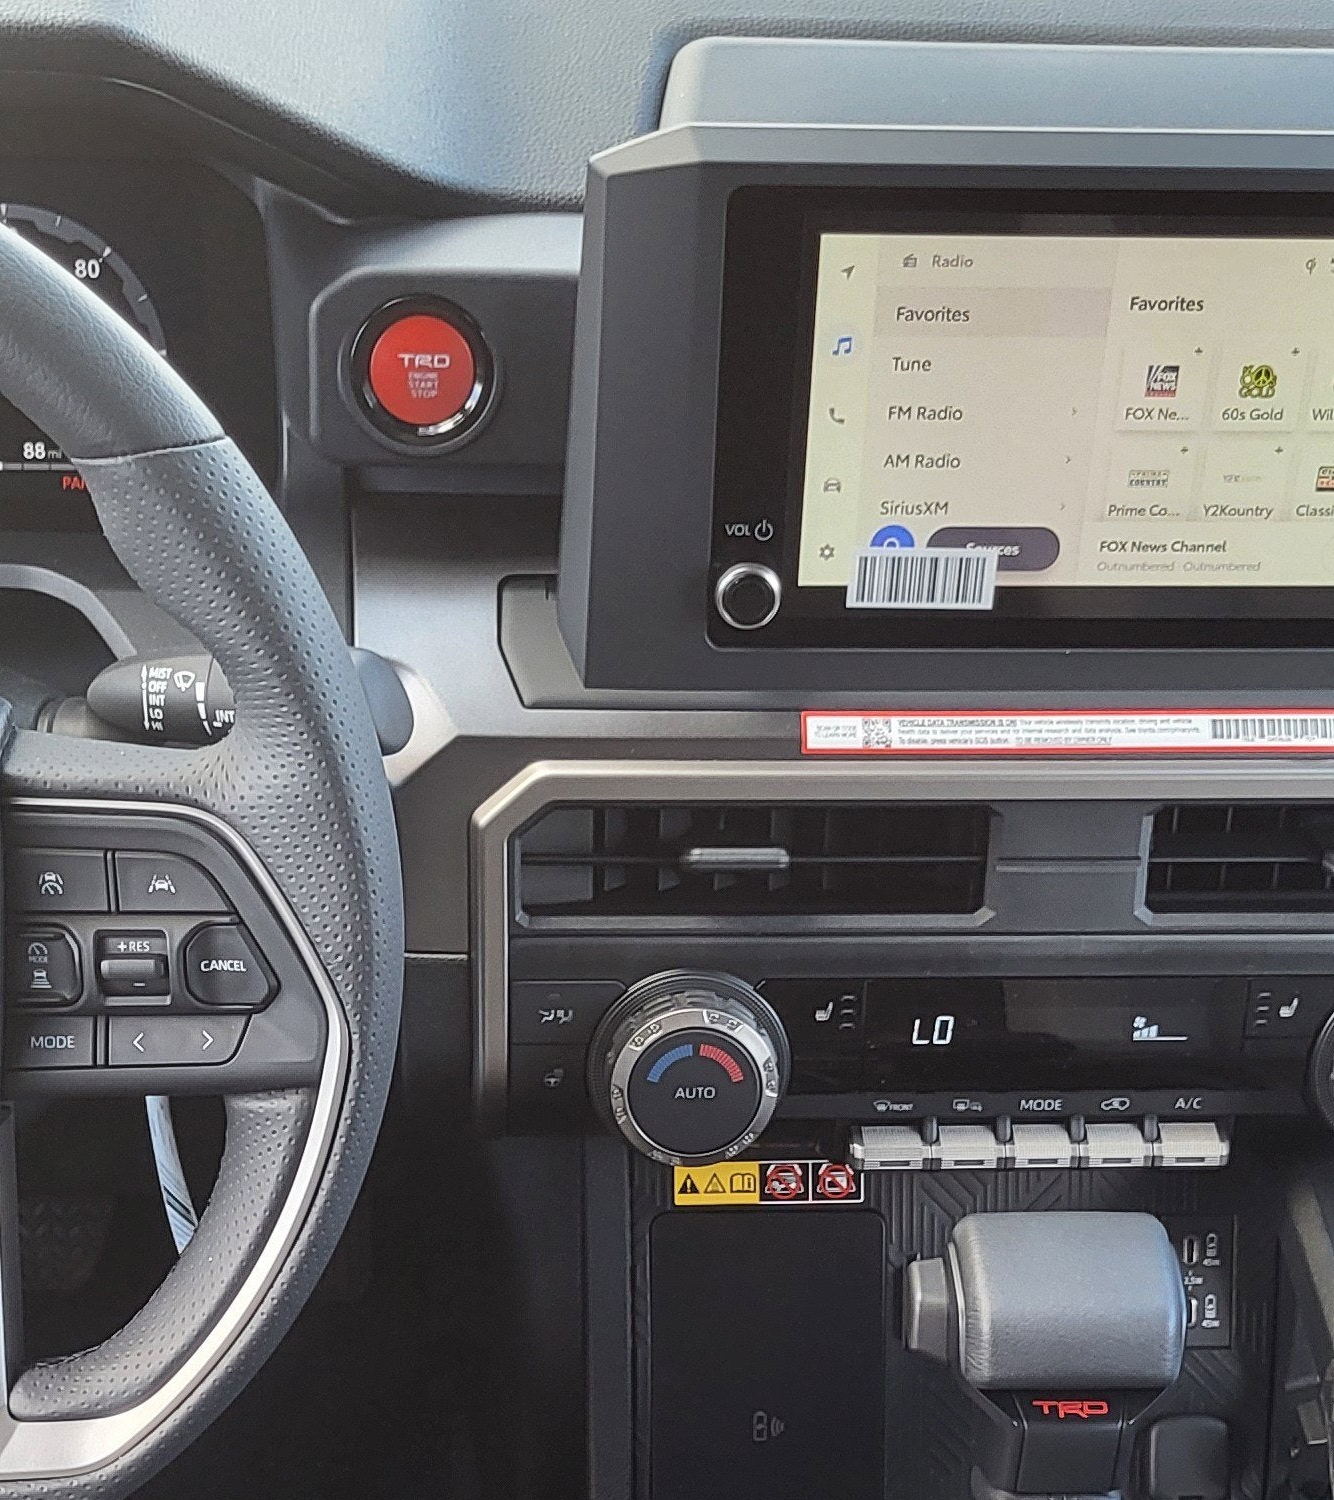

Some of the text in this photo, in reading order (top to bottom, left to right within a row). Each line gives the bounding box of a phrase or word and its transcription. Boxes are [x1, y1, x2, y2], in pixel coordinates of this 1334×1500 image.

[932, 254, 974, 268] Radio
[74, 258, 101, 279] 80
[1129, 295, 1204, 312] Favorites
[896, 306, 970, 323] Favorites
[397, 354, 451, 369] TRD
[892, 356, 932, 373] Tune
[408, 380, 440, 389] START
[410, 389, 438, 398] STOP
[887, 405, 964, 421] FM Radio
[1124, 408, 1153, 421] FOX
[1221, 408, 1284, 421] 60s Gold
[23, 441, 46, 460] 88
[883, 453, 961, 469] AM Radio
[880, 500, 949, 516] SiriusXM
[1107, 504, 1146, 517] Prime
[1203, 504, 1275, 520] Y2Kountry
[724, 524, 751, 536] VOL
[1099, 540, 1227, 552] FOX News Channel
[148, 667, 173, 680] MIST
[148, 681, 167, 693] OFF
[148, 695, 166, 707] INT
[149, 708, 164, 720] LO
[215, 709, 235, 724] INT
[200, 959, 247, 973] CANCEL
[912, 1015, 955, 1046] LO
[30, 1035, 76, 1049] MODE
[674, 1085, 716, 1100] AUTO
[889, 1102, 914, 1112] FRONT
[1019, 1098, 1063, 1112] MODE
[1174, 1096, 1204, 1110] A/C
[1031, 1399, 1110, 1419] TRD
